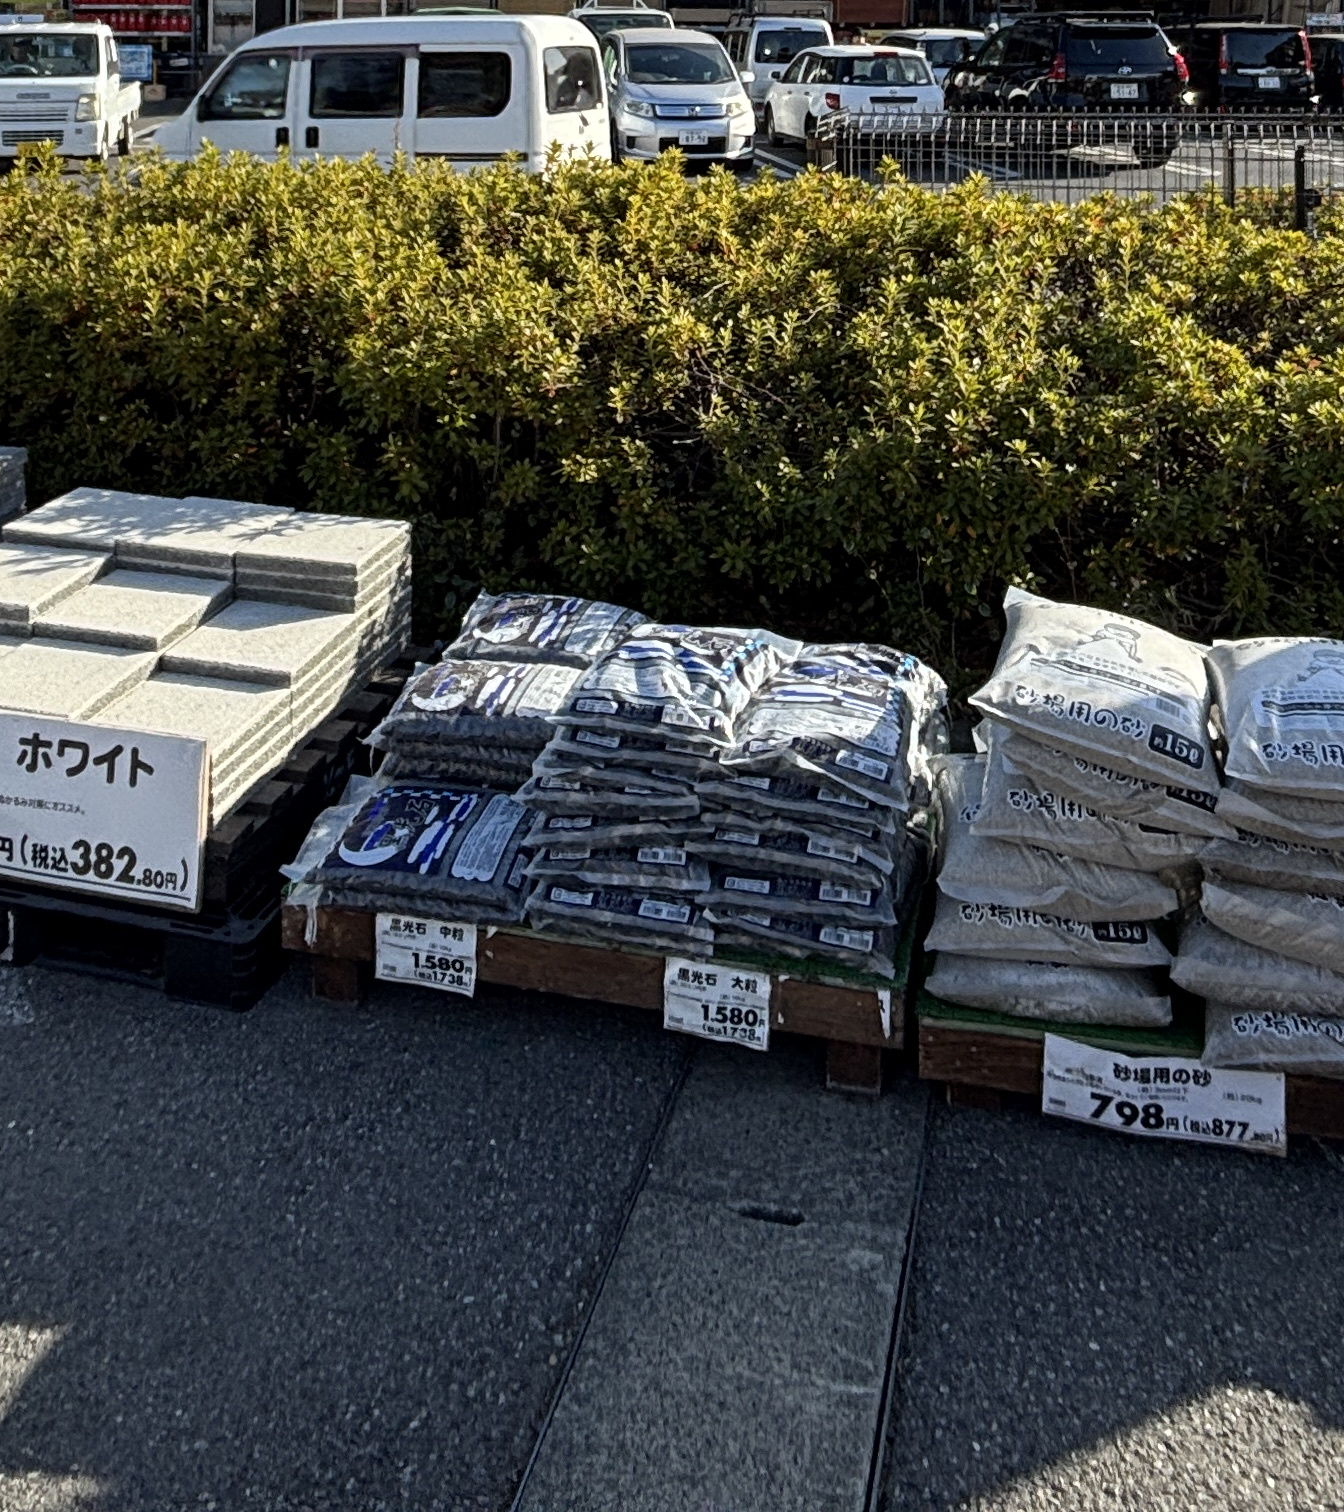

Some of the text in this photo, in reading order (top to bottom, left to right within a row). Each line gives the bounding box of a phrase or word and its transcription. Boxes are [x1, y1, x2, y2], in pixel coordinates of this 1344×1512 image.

[16, 732, 156, 788] ホワイト
[1112, 1062, 1213, 1088] 砂場用の砂
